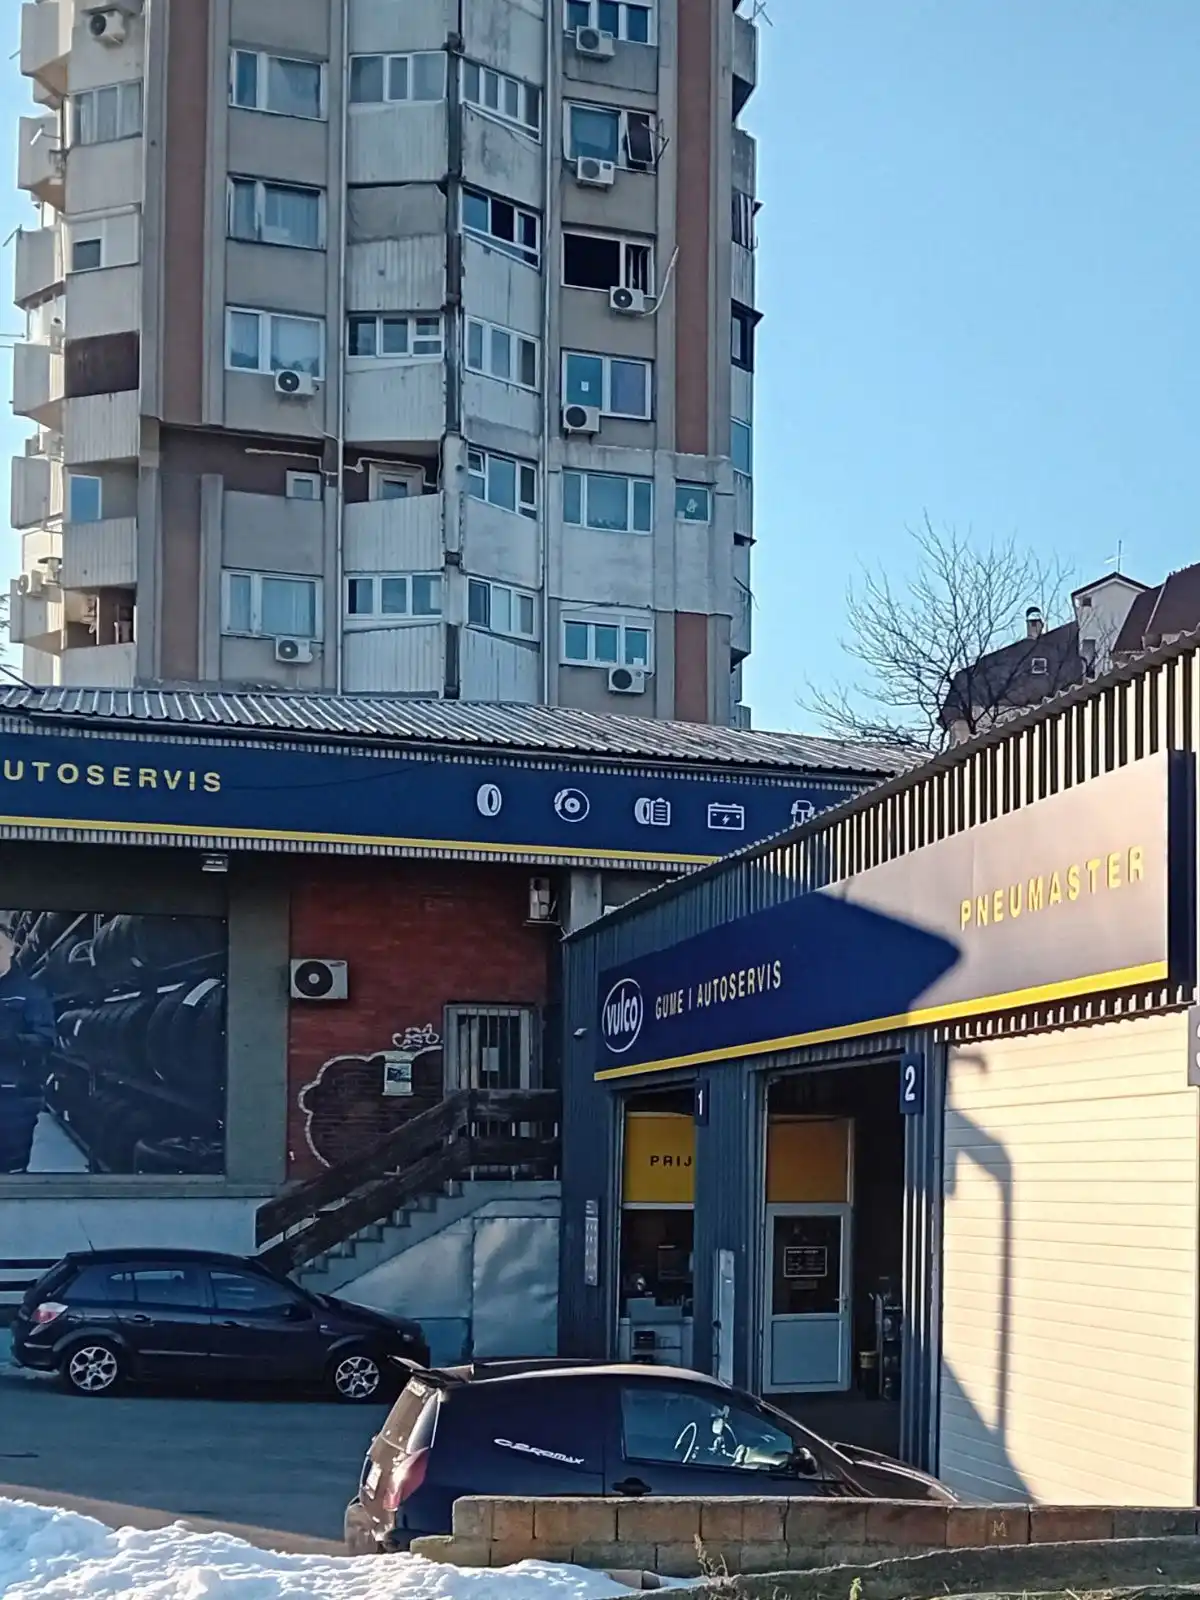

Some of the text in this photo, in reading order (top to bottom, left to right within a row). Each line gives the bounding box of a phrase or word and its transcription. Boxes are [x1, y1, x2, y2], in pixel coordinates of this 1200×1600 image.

[3, 759, 221, 792] UTOSERVIS
[960, 845, 1144, 931] PNEUMASTER
[655, 989, 684, 1020] GUME
[697, 960, 781, 1008] AUTOSERVIS
[607, 988, 639, 1036] vulco
[698, 1089, 703, 1116] 1
[905, 1065, 916, 1101] 2
